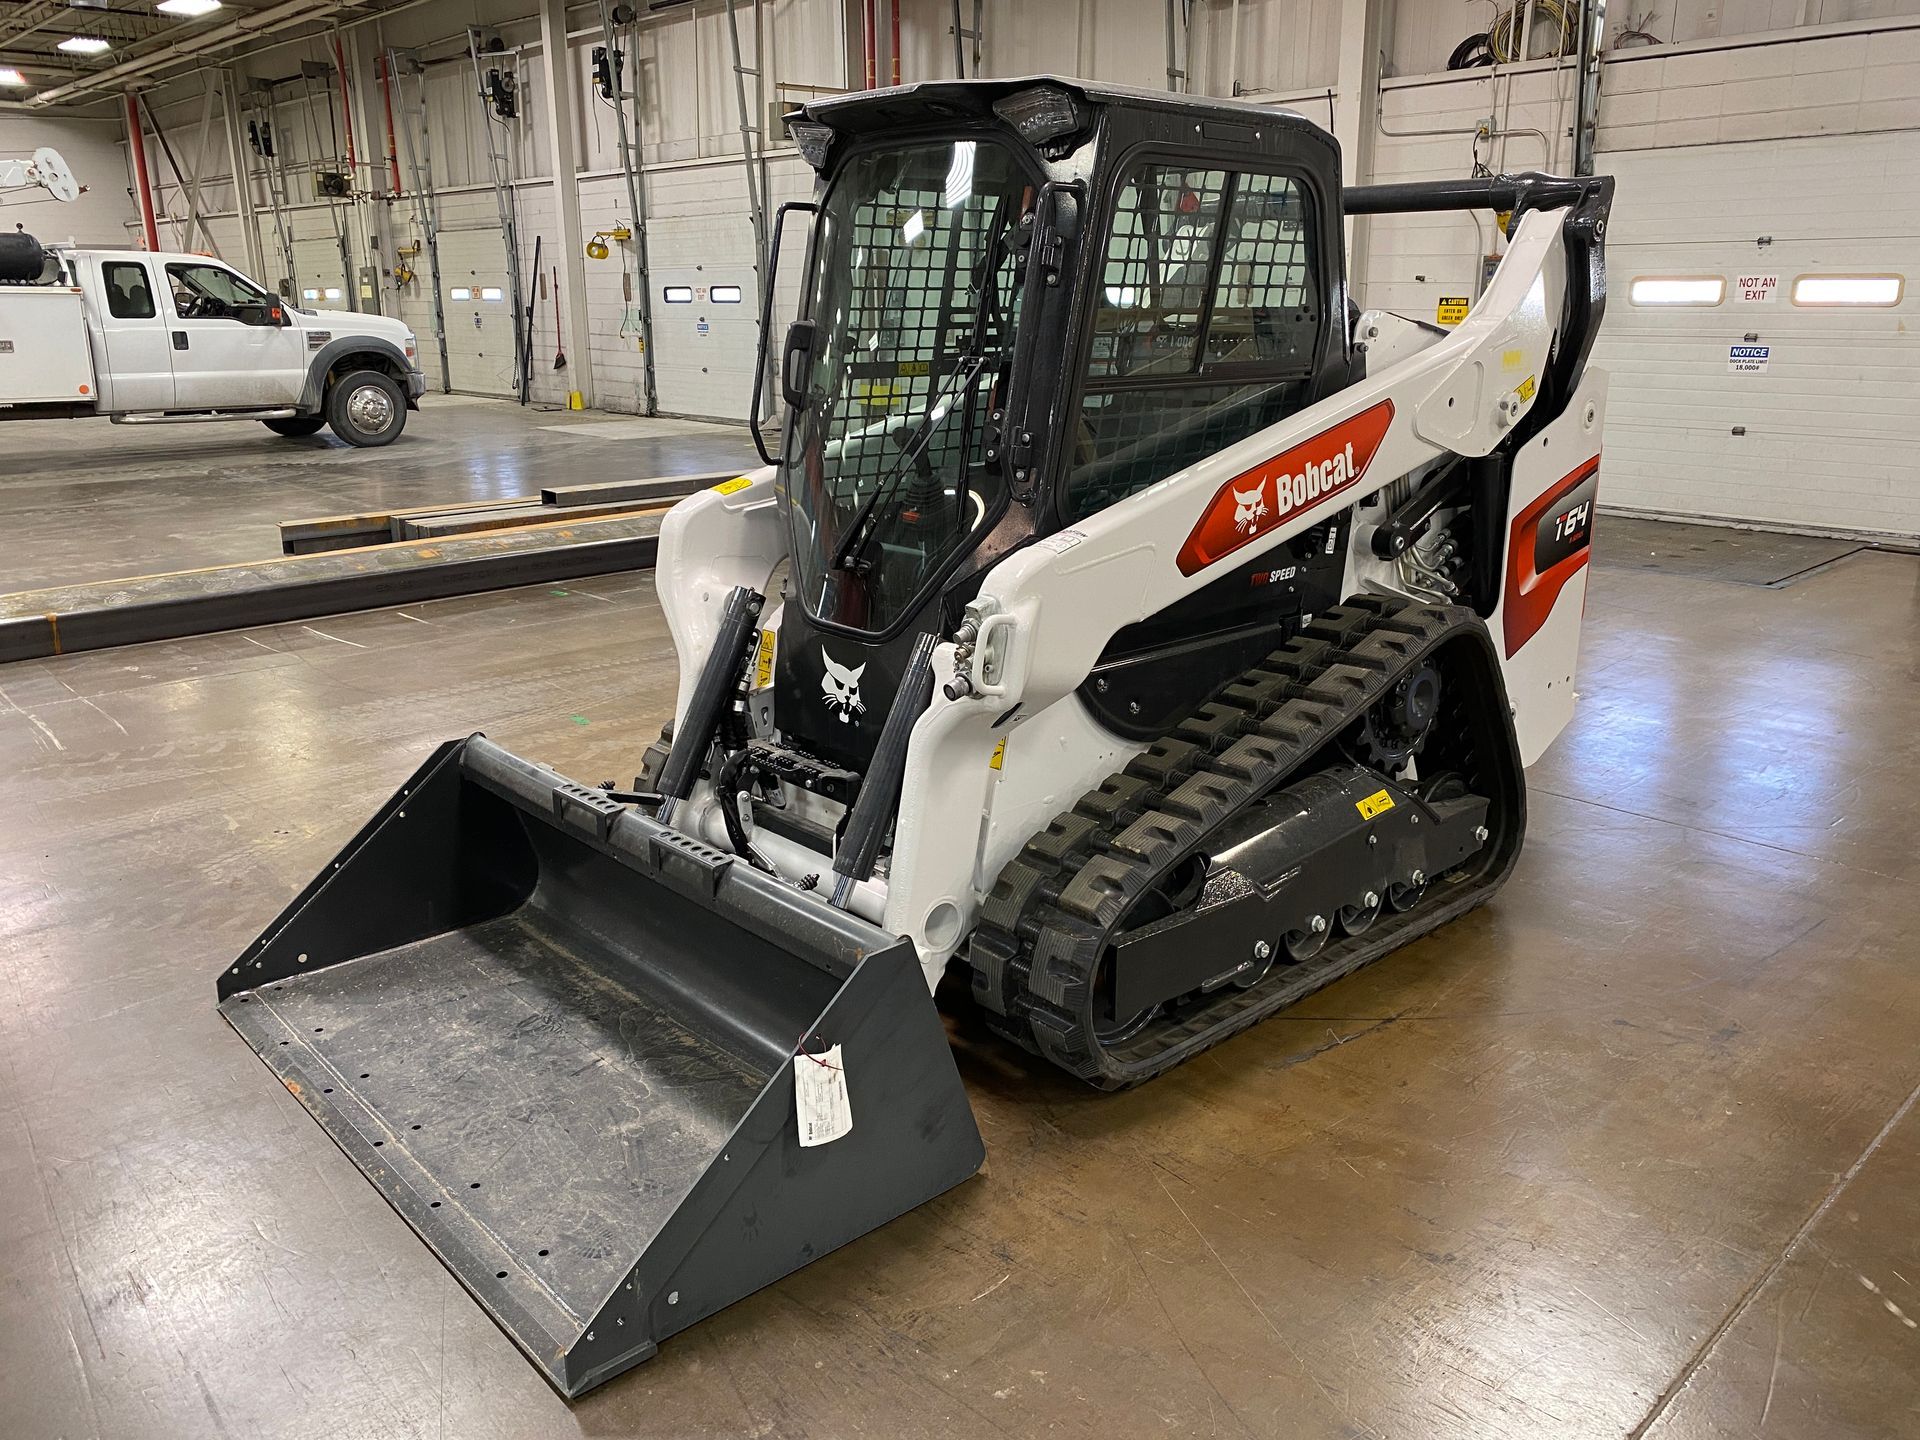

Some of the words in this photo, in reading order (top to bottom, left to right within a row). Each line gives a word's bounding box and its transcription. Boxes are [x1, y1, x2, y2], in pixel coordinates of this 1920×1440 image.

[1739, 277, 1760, 288] NOT
[1761, 277, 1777, 288] AN
[1744, 290, 1767, 301] EXIT
[1731, 347, 1768, 357] NOTICE
[1276, 442, 1356, 516] Bobcat
[1251, 573, 1269, 586] TWO
[1269, 566, 1296, 583] SPEED
